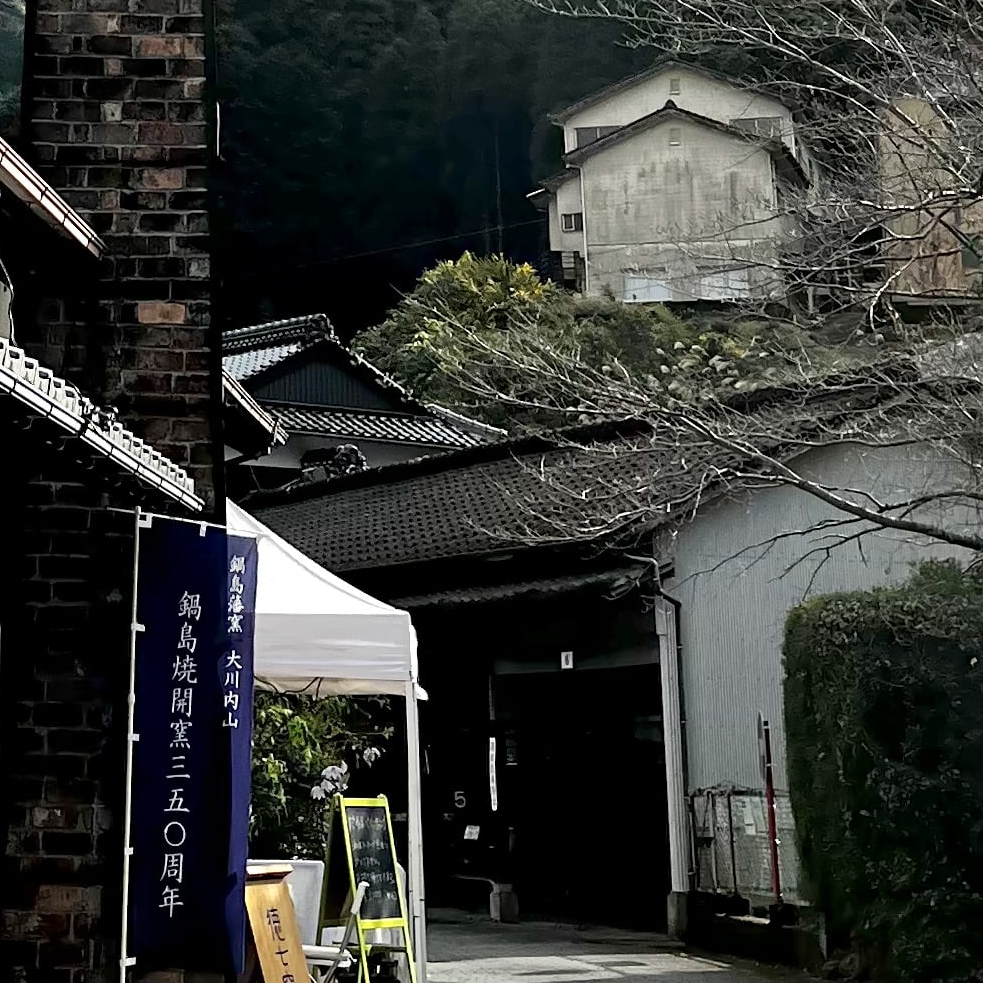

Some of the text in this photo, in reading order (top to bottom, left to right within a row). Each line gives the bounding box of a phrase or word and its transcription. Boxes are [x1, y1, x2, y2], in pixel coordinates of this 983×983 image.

[222, 650, 243, 728] 大川内山
[454, 790, 467, 808] 5
